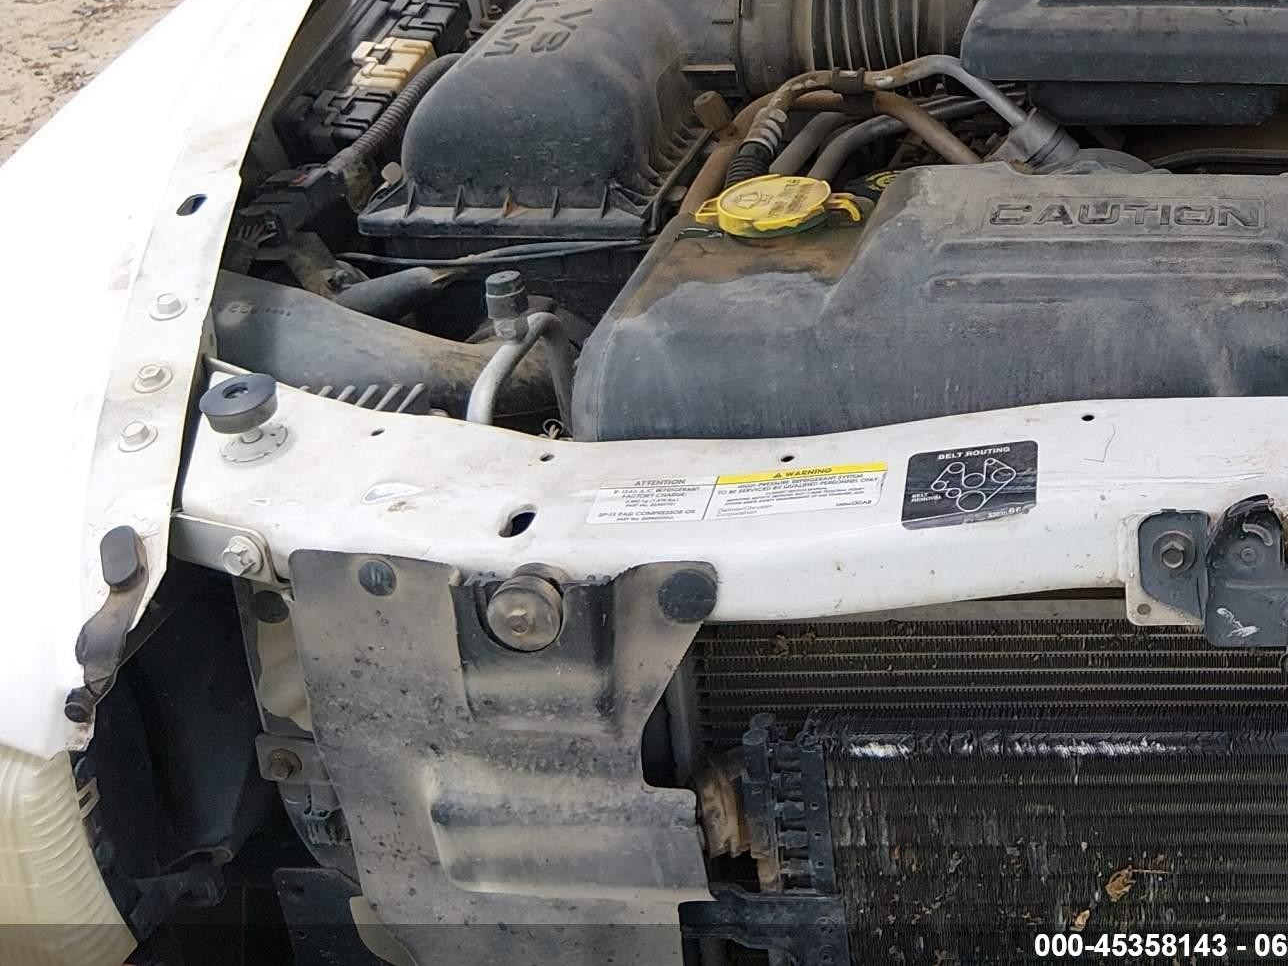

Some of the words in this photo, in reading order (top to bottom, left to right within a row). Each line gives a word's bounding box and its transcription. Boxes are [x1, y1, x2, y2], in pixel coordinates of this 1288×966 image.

[989, 203, 1260, 227] CAUTION
[938, 451, 964, 460] BELT
[965, 446, 1011, 457] ROUTING
[785, 468, 832, 477] WARNING
